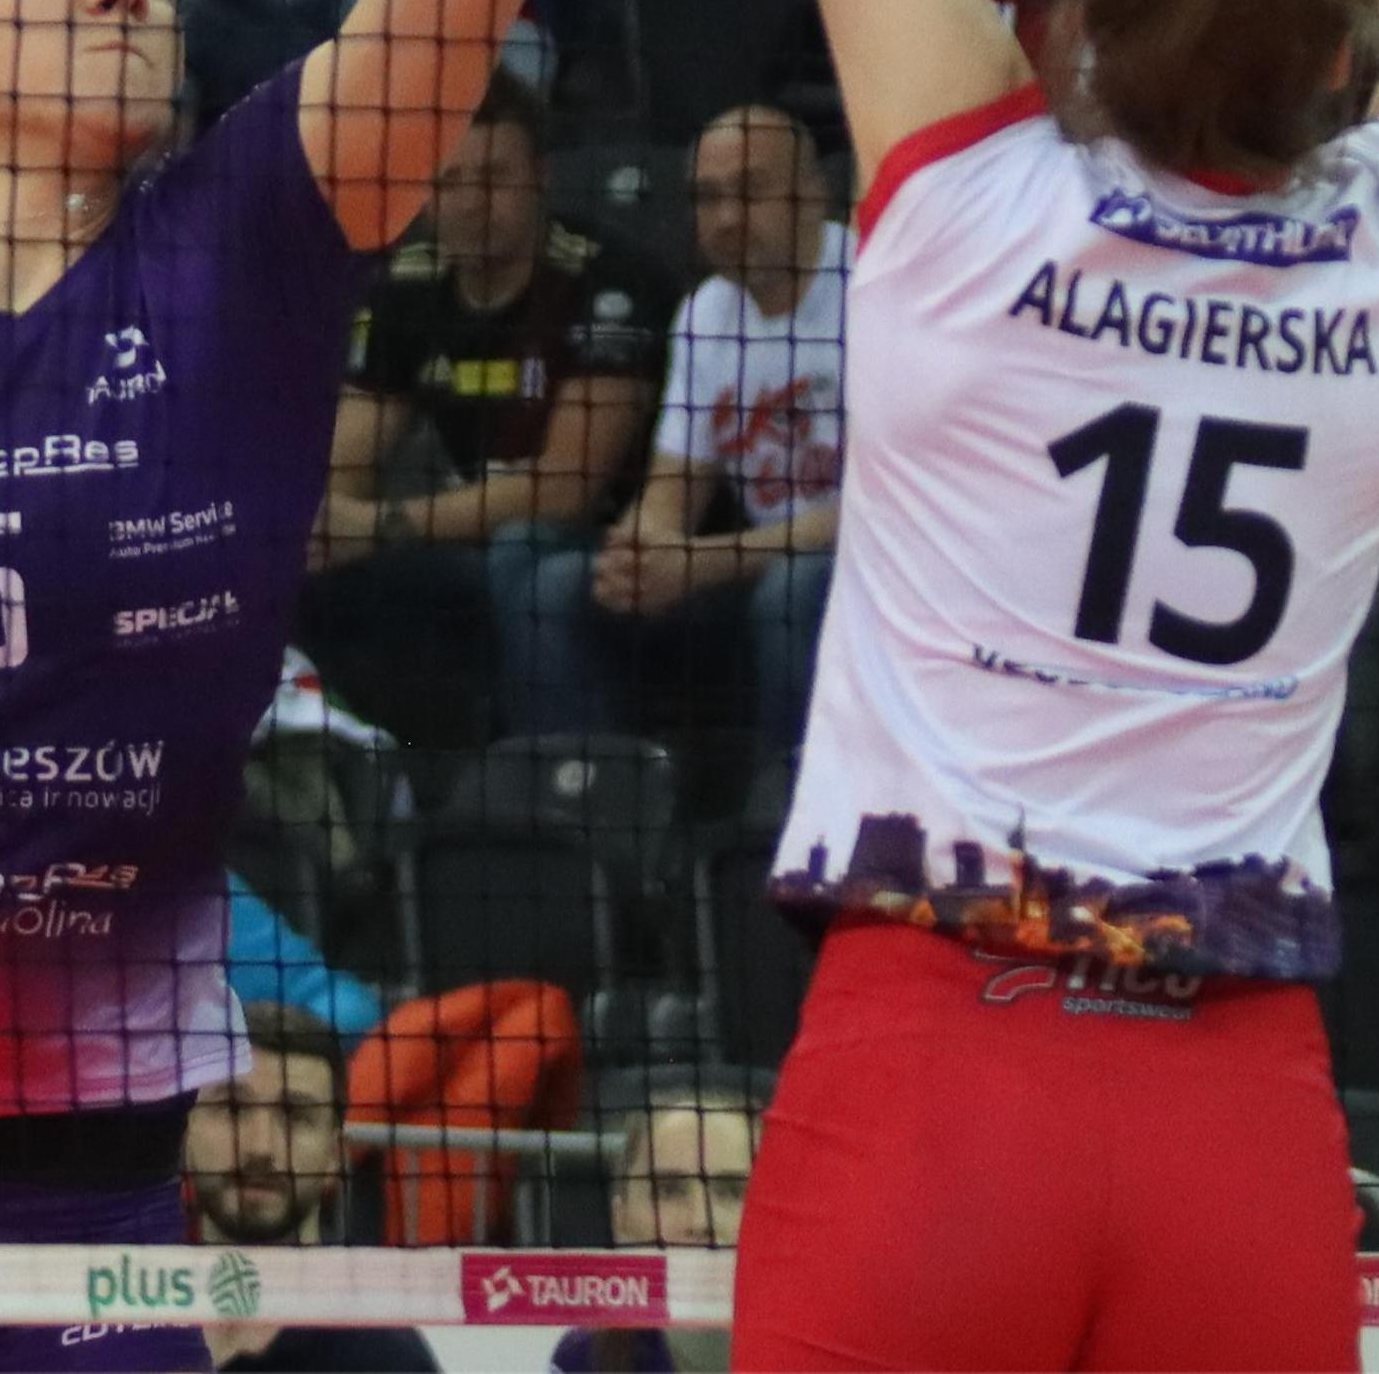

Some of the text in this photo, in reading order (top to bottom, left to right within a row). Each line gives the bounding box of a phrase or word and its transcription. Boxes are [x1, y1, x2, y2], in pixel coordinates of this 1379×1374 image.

[1009, 260, 1378, 376] ALAGIERSKA
[1047, 402, 1309, 665] 15
[85, 1256, 195, 1317] plus
[526, 1274, 649, 1308] TAURON
